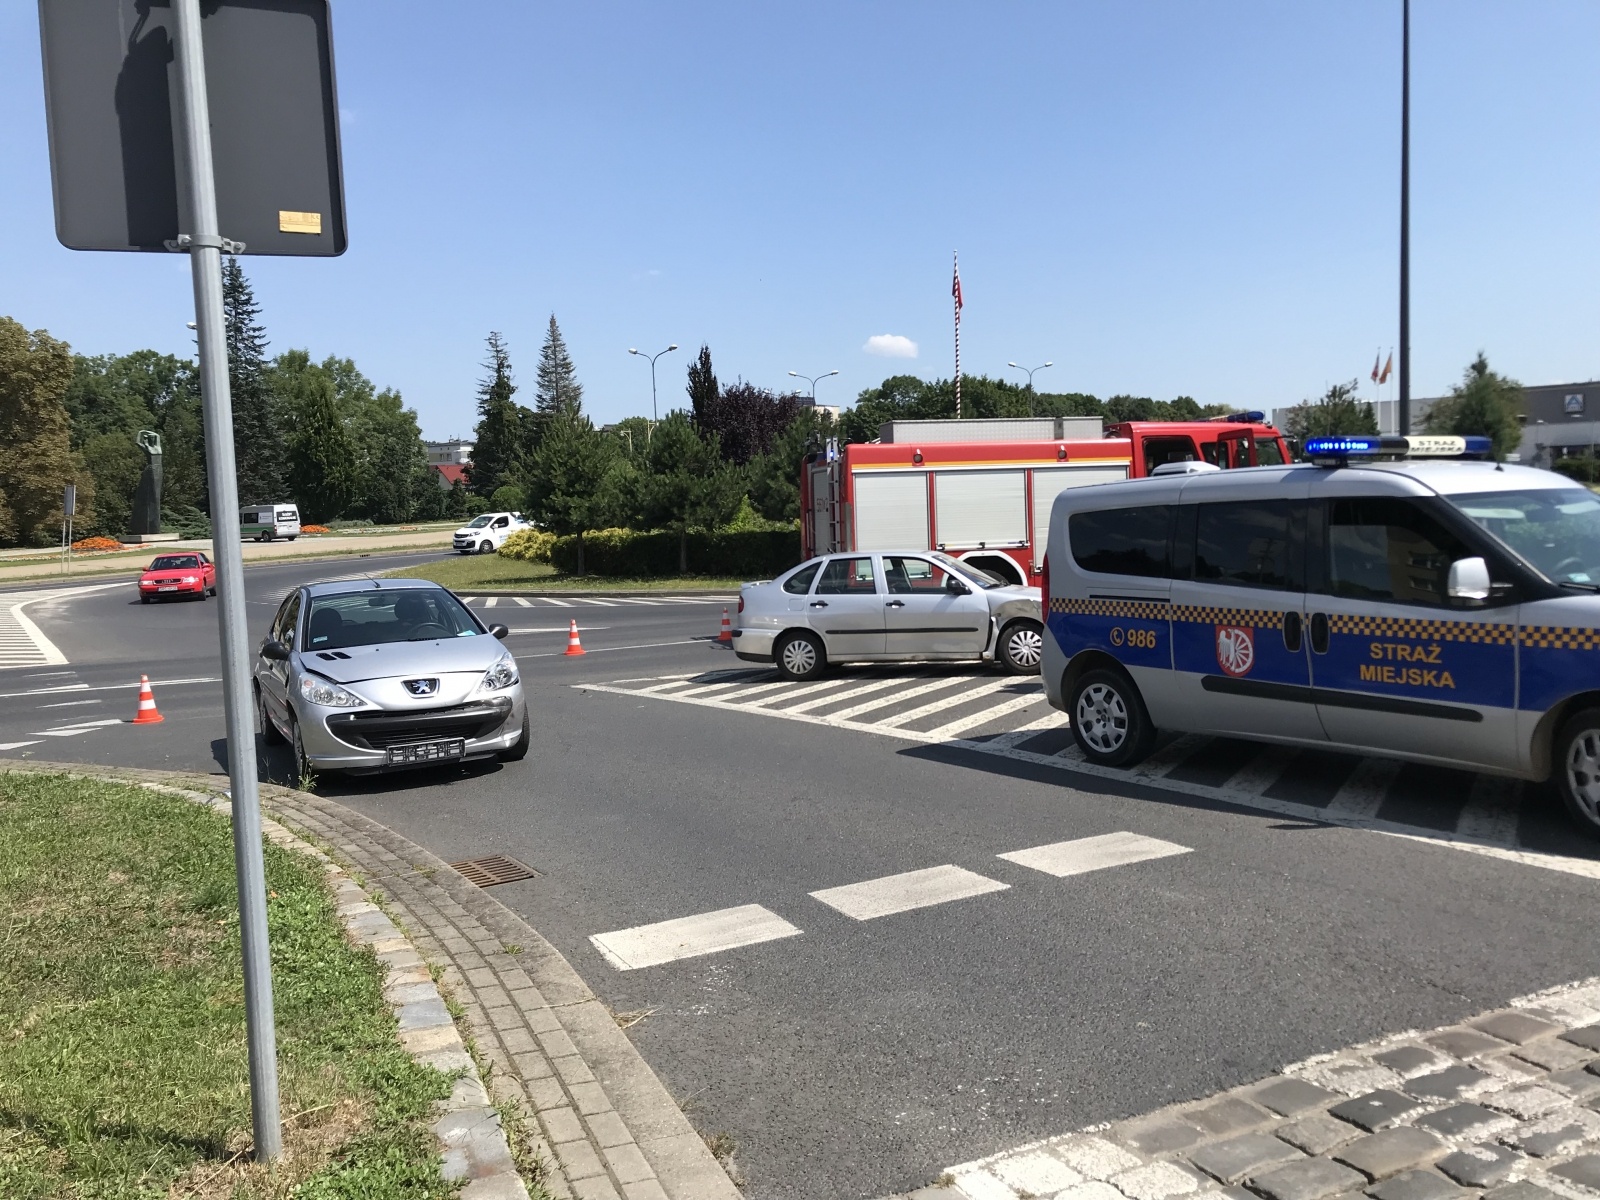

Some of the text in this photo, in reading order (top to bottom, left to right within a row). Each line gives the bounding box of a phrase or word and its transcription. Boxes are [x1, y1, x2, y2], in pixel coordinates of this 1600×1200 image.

[1127, 629, 1156, 649] 986
[1369, 642, 1443, 664] STRAŻ
[1359, 664, 1456, 689] MIEJSKA
